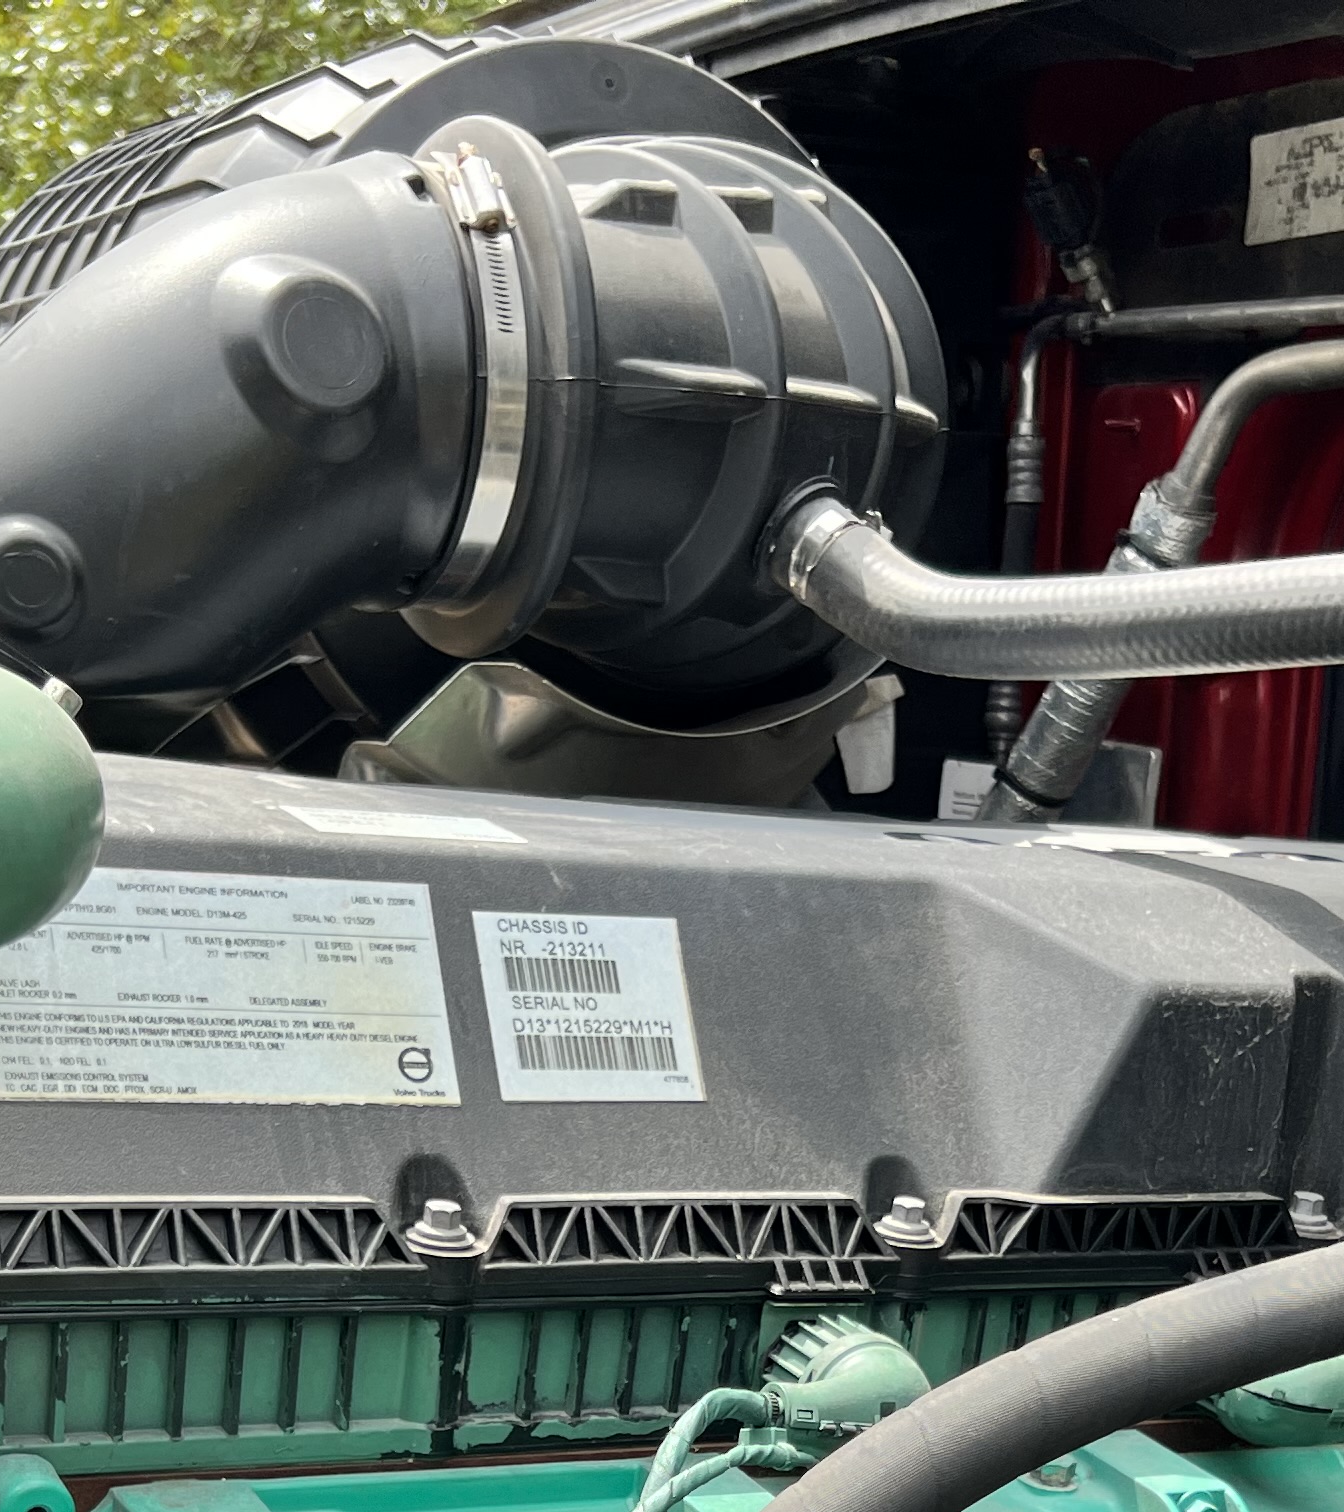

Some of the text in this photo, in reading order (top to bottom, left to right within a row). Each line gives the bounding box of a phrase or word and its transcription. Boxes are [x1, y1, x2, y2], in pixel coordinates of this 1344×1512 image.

[116, 883, 288, 899] IMPORTANT ENGINE INFORMATION
[136, 907, 248, 920] ENGINE D13M-425
[292, 914, 321, 924] SERIAL
[497, 918, 588, 935] CHASSIS ID
[67, 931, 112, 942] ADVERTISED
[499, 940, 606, 957] NR -213211
[20, 979, 41, 988] LASH
[512, 995, 598, 1011] SERIAL NO
[14, 1012, 42, 1022] ENGINE
[144, 1016, 186, 1025] CALIFORNIA
[337, 1022, 356, 1030] YEAR
[15, 1036, 44, 1045] ENGINE
[4, 1072, 39, 1081] EXHAUST
[82, 1073, 116, 1082] CONTROL
[118, 1074, 149, 1082] SYSTEM
[393, 1089, 446, 1098] Volvo Trucks
